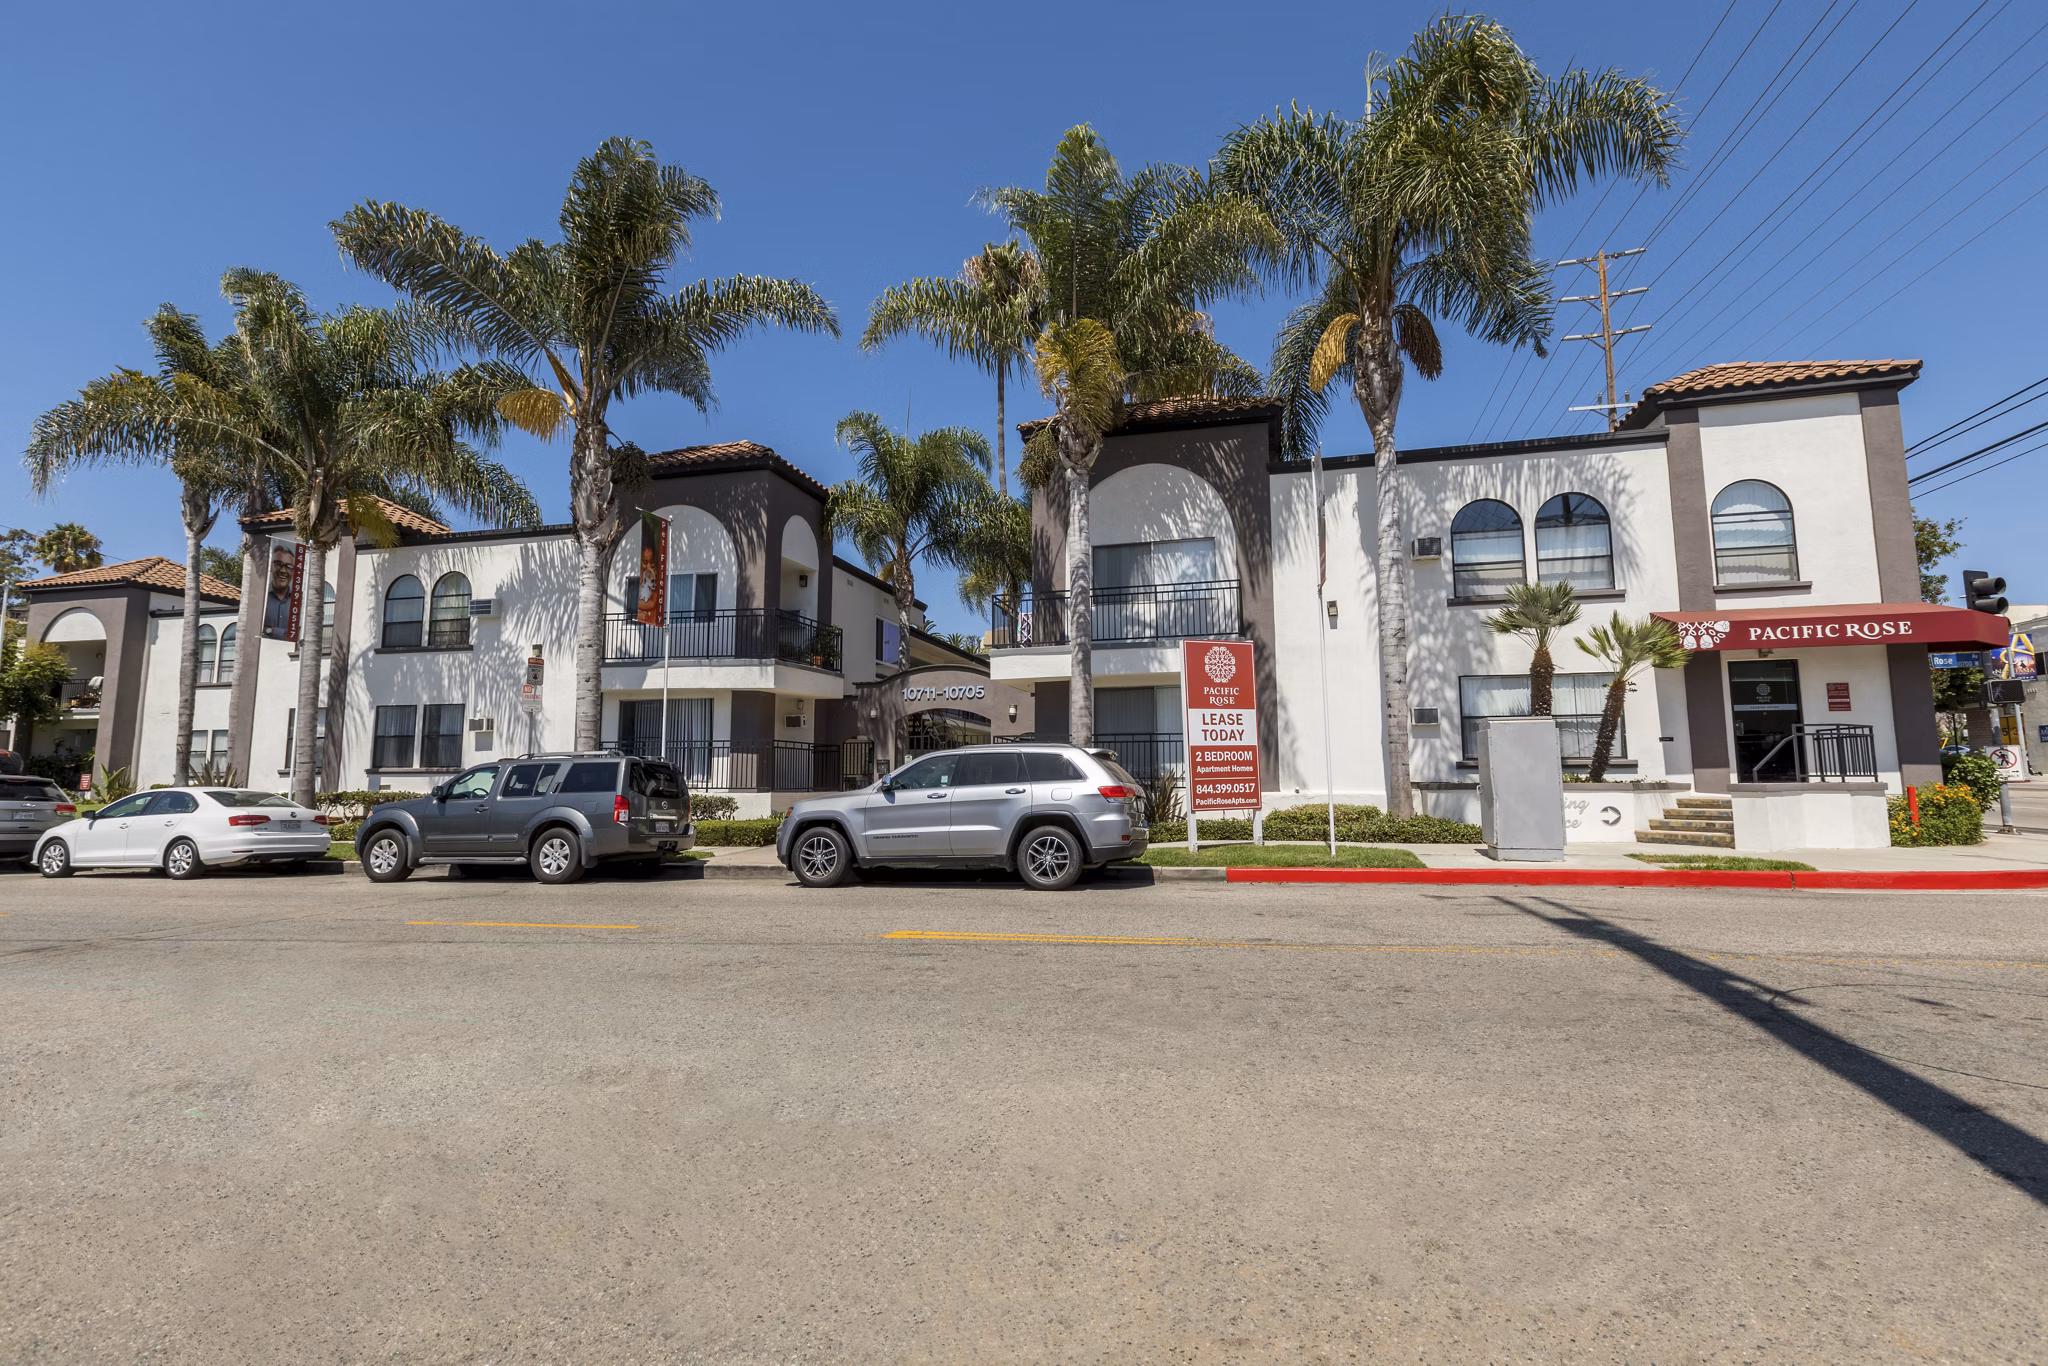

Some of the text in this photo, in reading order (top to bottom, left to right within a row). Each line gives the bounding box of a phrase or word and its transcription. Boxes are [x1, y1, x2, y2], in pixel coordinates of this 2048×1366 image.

[657, 553, 665, 623] Friendly
[1748, 621, 1913, 641] PACIFIC ROSE
[1933, 657, 1953, 665] Rose
[523, 685, 532, 693] NO
[901, 685, 985, 701] 10711-10705
[1203, 686, 1240, 696] PACIFIC
[1209, 696, 1236, 706] ROSE
[1202, 713, 1244, 726] LEASE
[1201, 729, 1245, 741] TODAY
[1195, 750, 1253, 762] 2 BEDROOM
[1196, 764, 1254, 774] Apartment Homes
[1196, 782, 1255, 795] 844.399.0517
[1195, 797, 1257, 806] PacificRoseApts.com
